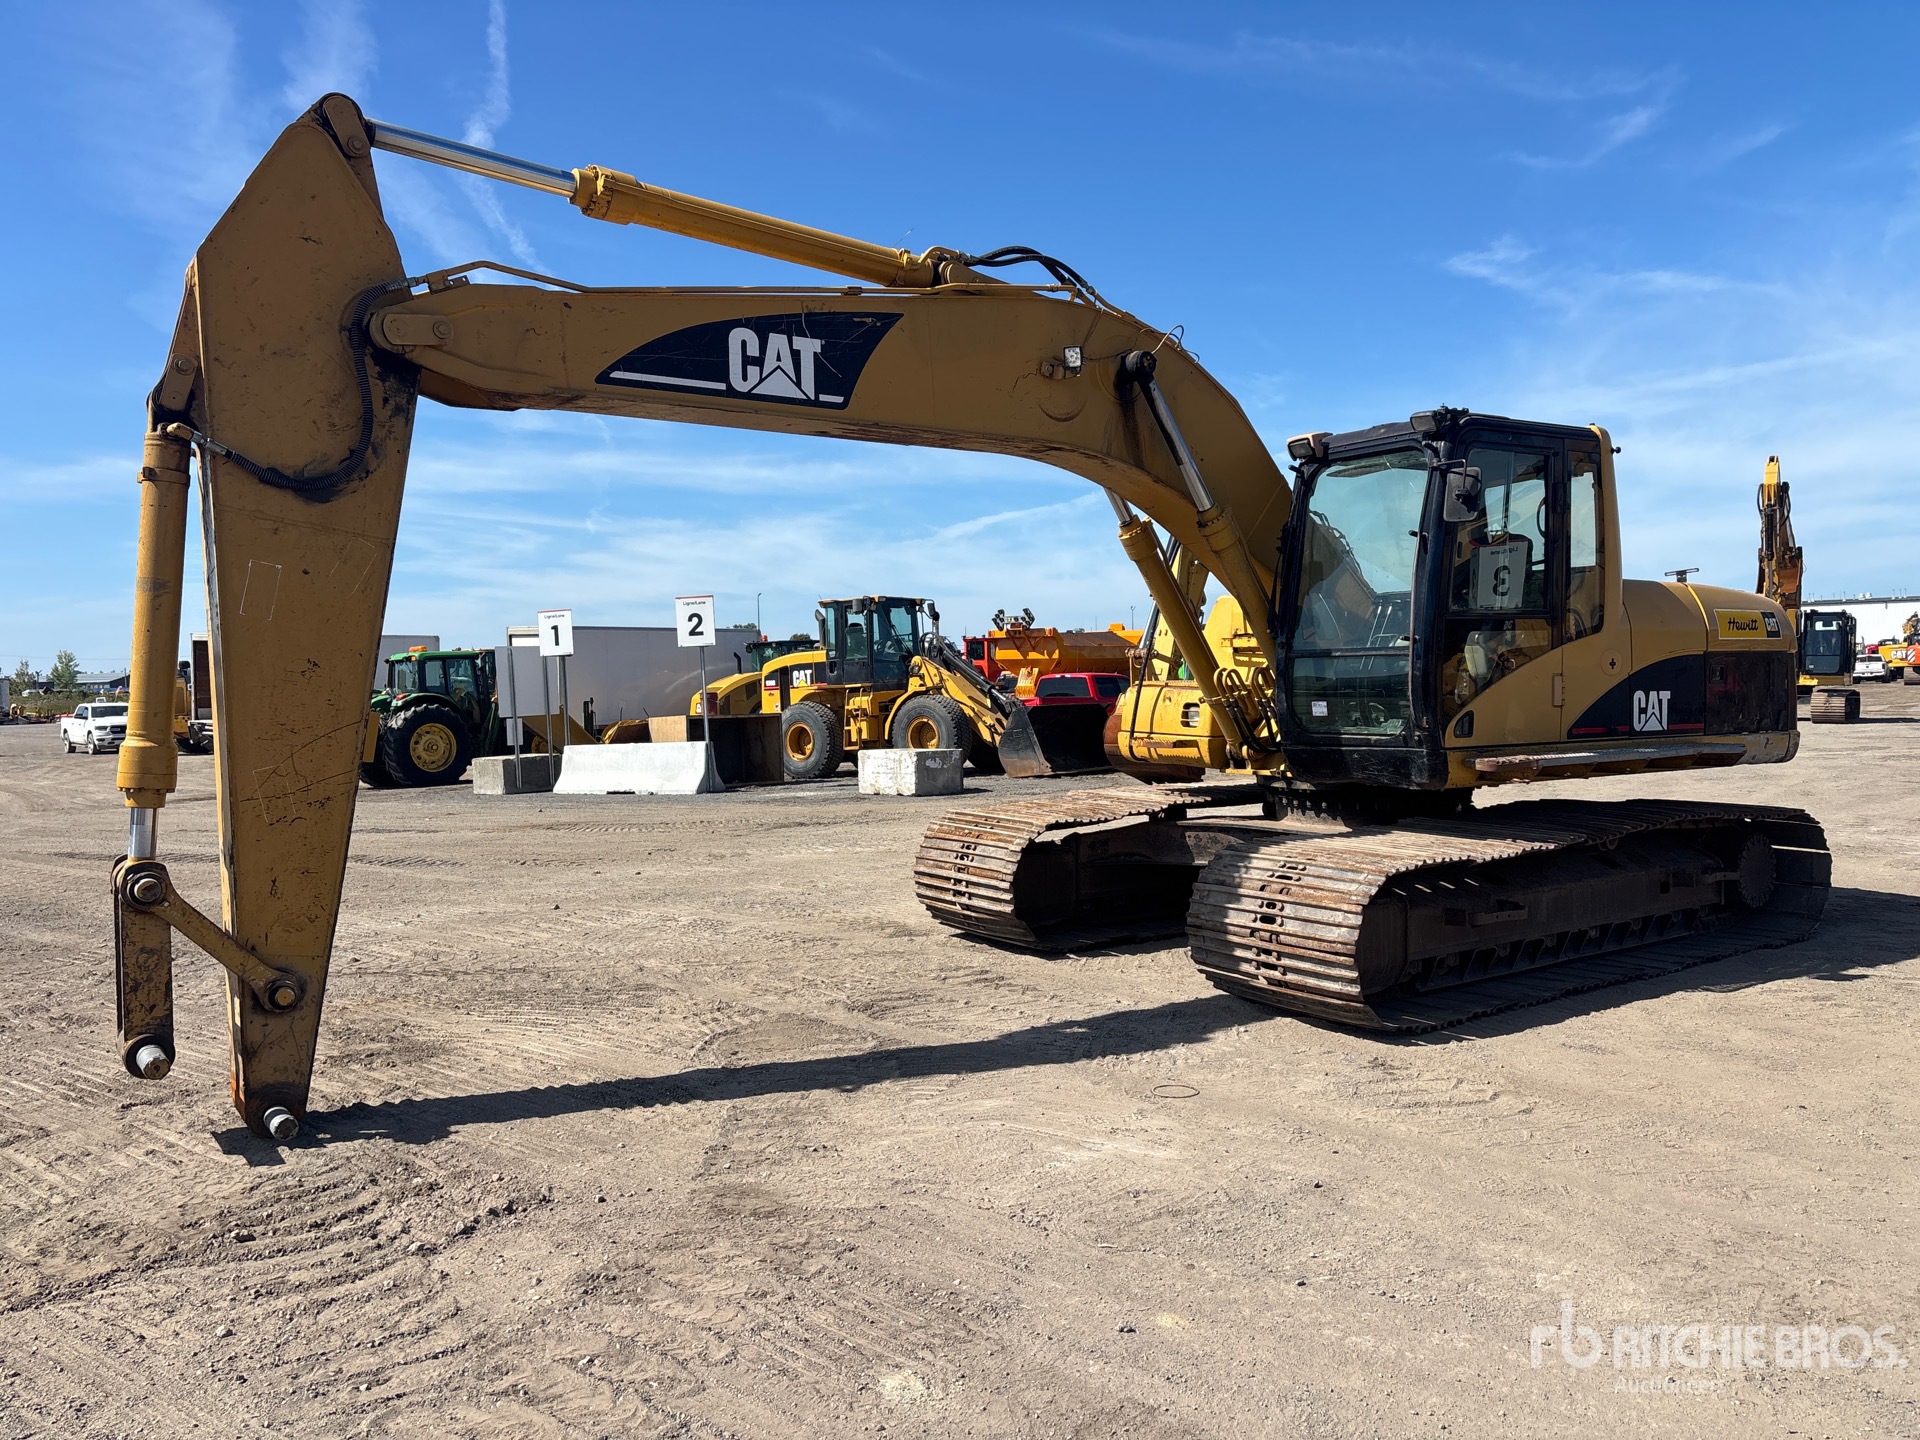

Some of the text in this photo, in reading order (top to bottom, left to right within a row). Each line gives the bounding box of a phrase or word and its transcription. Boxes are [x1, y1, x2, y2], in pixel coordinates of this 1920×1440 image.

[728, 327, 822, 400] CAT
[551, 624, 560, 647] 1
[687, 612, 704, 637] 2
[1728, 617, 1779, 632] Hewitt CAT
[1891, 650, 1907, 660] CAT
[792, 669, 813, 688] CAT
[1633, 690, 1671, 732] CAT
